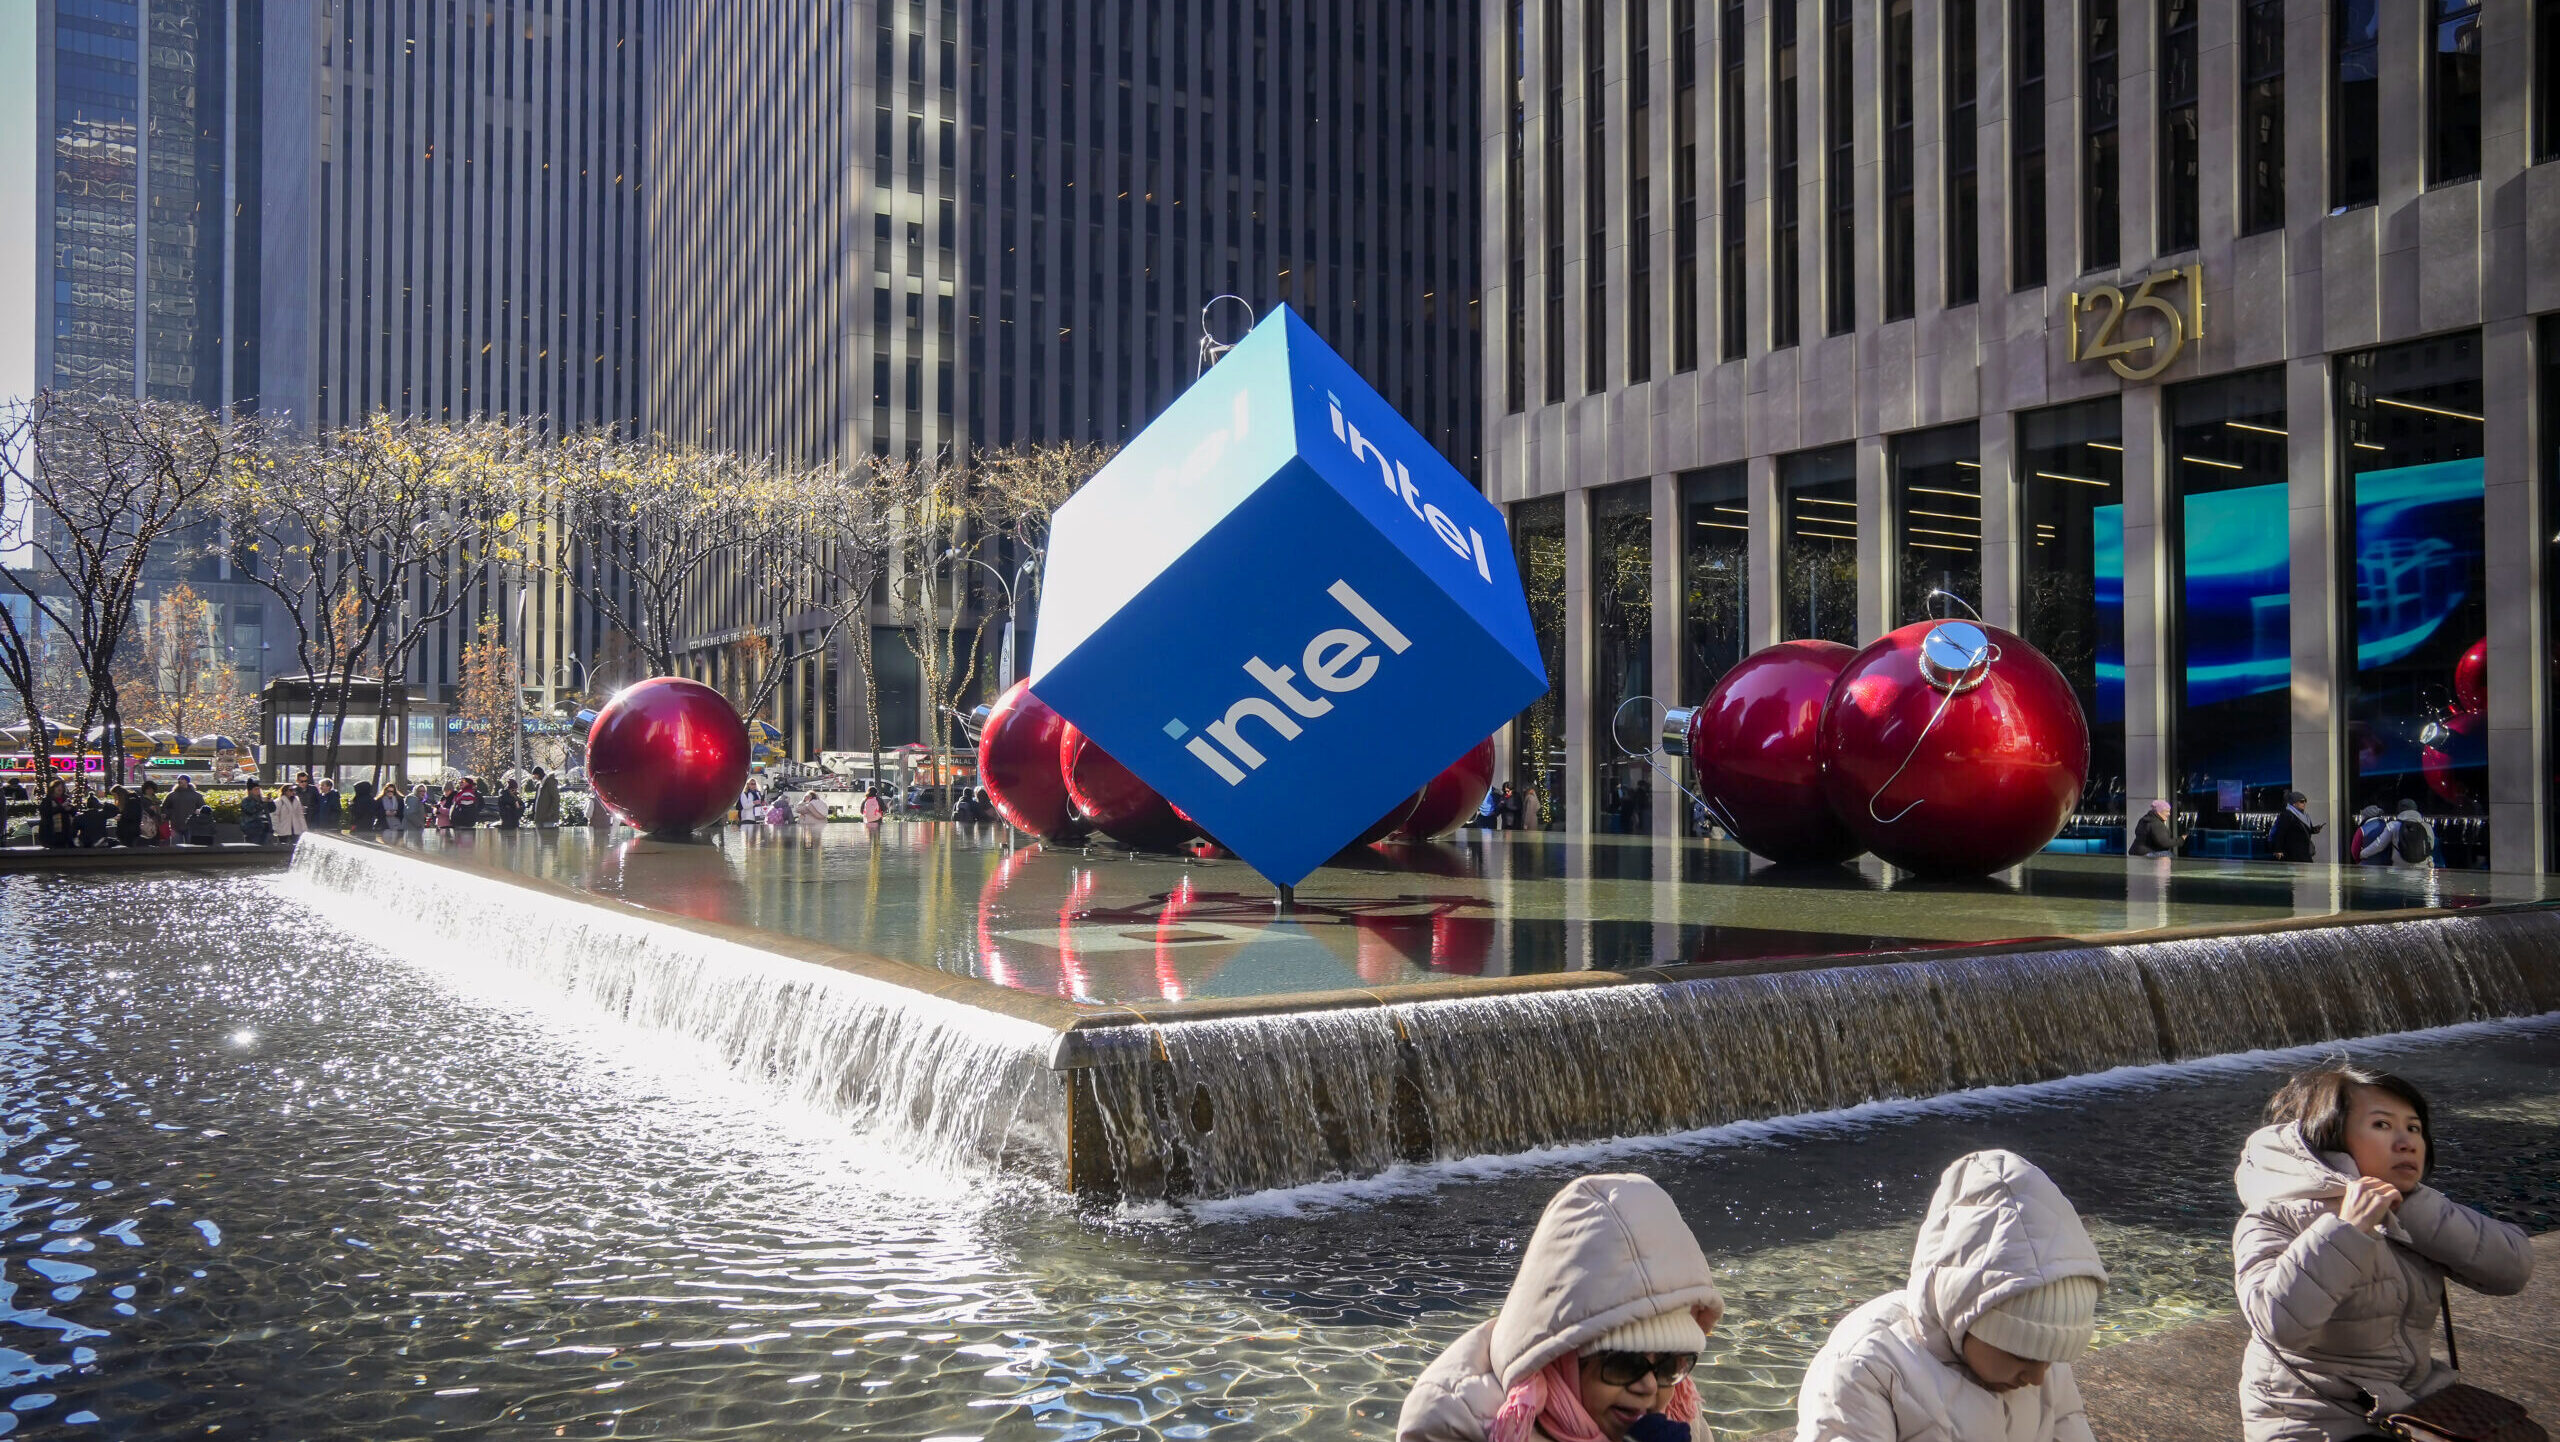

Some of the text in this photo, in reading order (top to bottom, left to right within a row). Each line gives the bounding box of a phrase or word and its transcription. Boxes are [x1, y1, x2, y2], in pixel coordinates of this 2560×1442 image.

[2064, 264, 2202, 381] 1251
[1327, 389, 1492, 584] intel
[701, 635, 720, 647] AVENUE
[721, 634, 728, 644] OF
[730, 631, 740, 642] THE
[1162, 578, 1413, 787] intel
[449, 719, 462, 730] off
